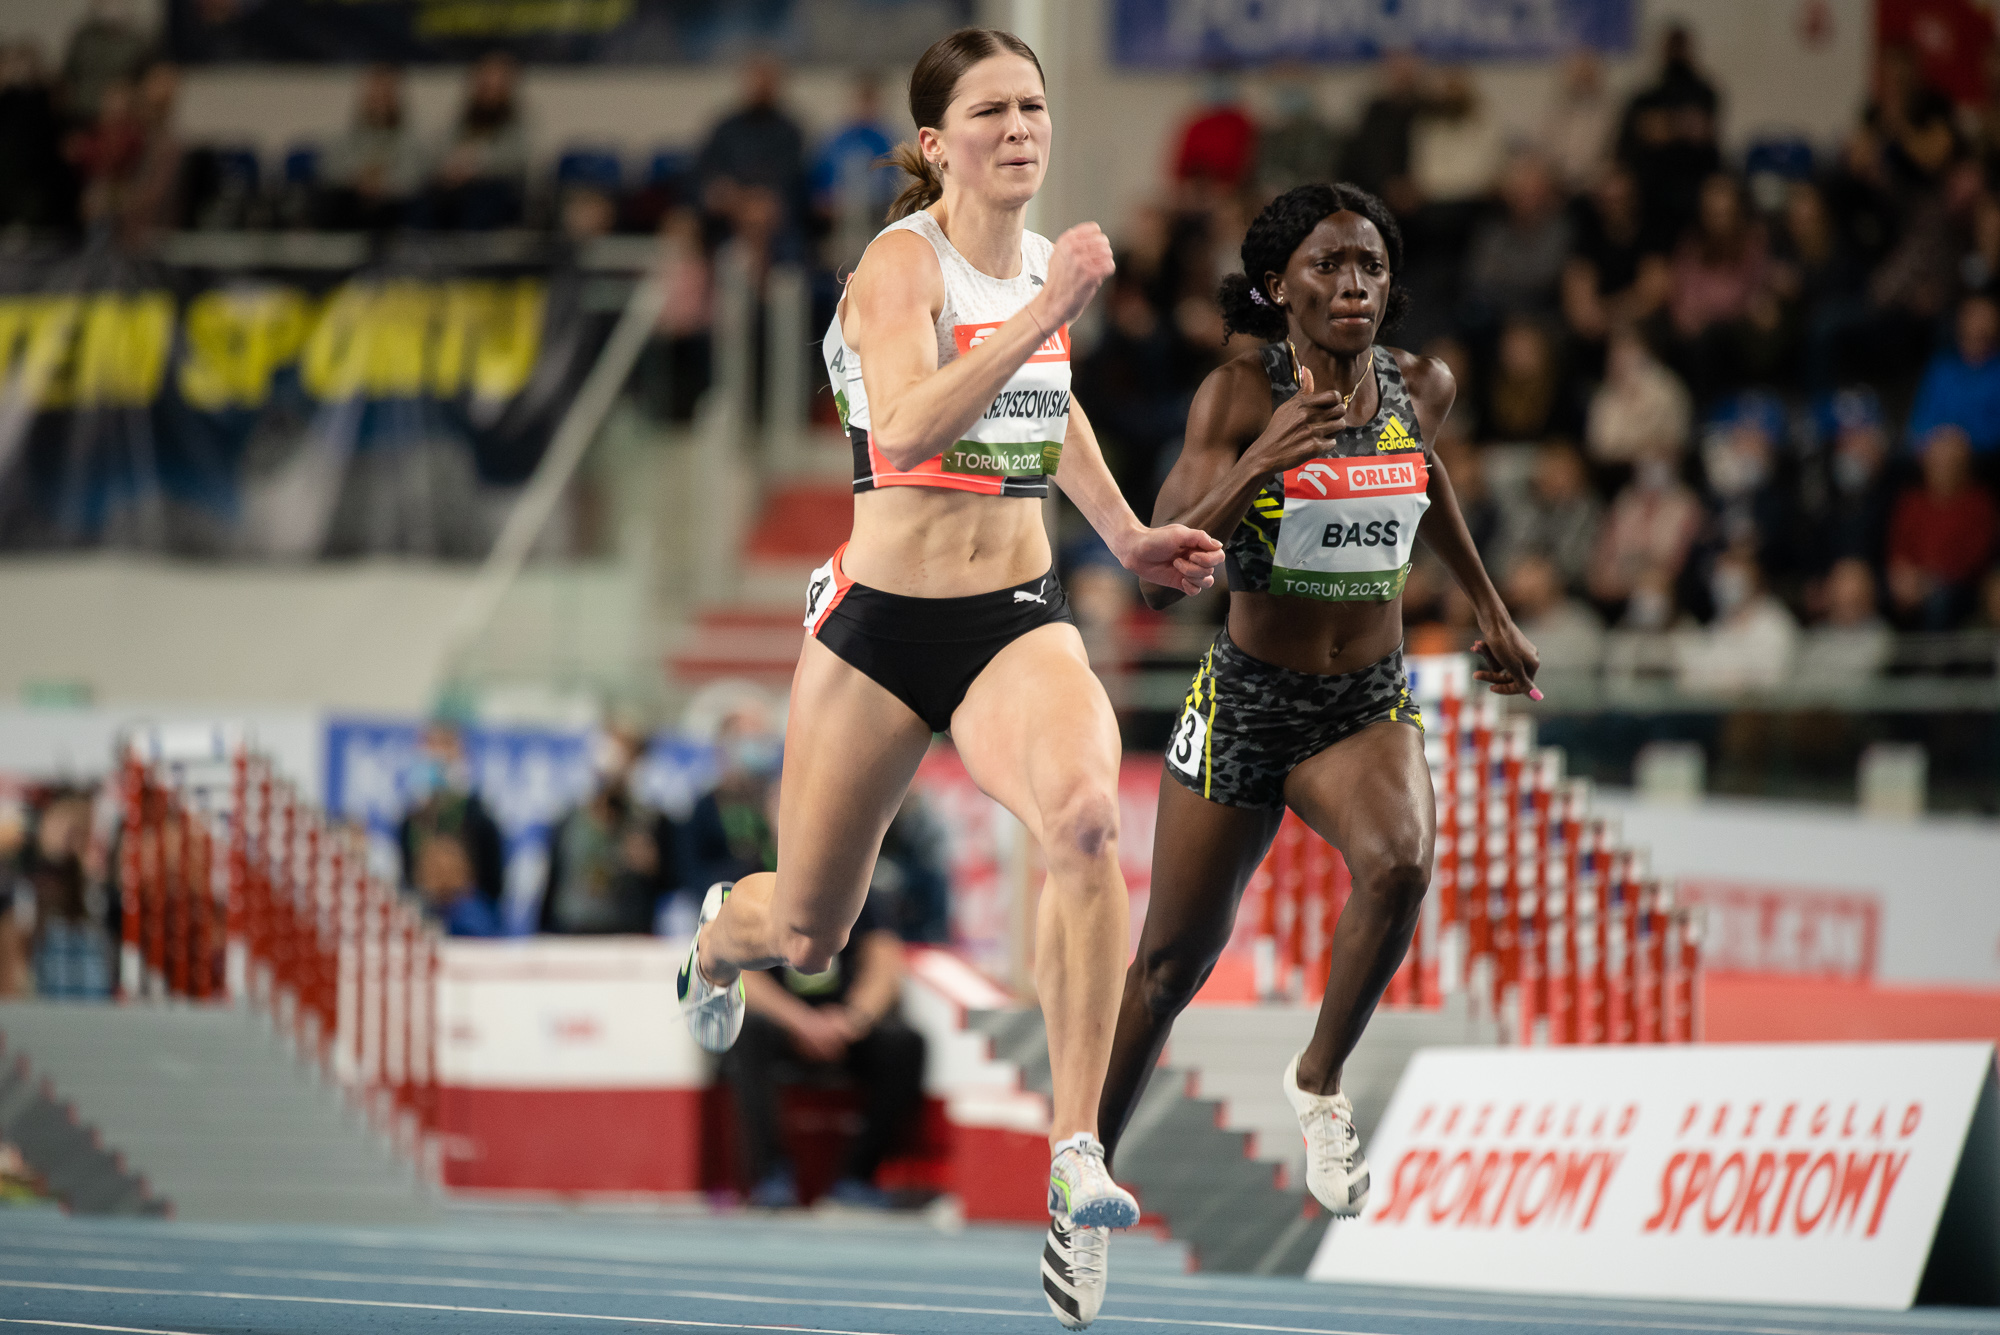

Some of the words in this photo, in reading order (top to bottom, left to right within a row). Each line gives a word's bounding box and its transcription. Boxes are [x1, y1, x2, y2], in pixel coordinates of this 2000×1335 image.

[984, 389, 1070, 420] RZYSZOWSKA
[1377, 436, 1416, 451] adidas
[954, 451, 1010, 471] TORUŃ
[1012, 453, 1041, 470] 2022
[1352, 466, 1412, 487] ORLEN
[1321, 519, 1401, 548] BASS
[1284, 579, 1346, 598] TORUŃ
[1348, 580, 1391, 597] 2022
[1175, 713, 1197, 765] 3
[1368, 1148, 1624, 1232] SPORTOWY
[1642, 1150, 1910, 1239] SPORTOWY
